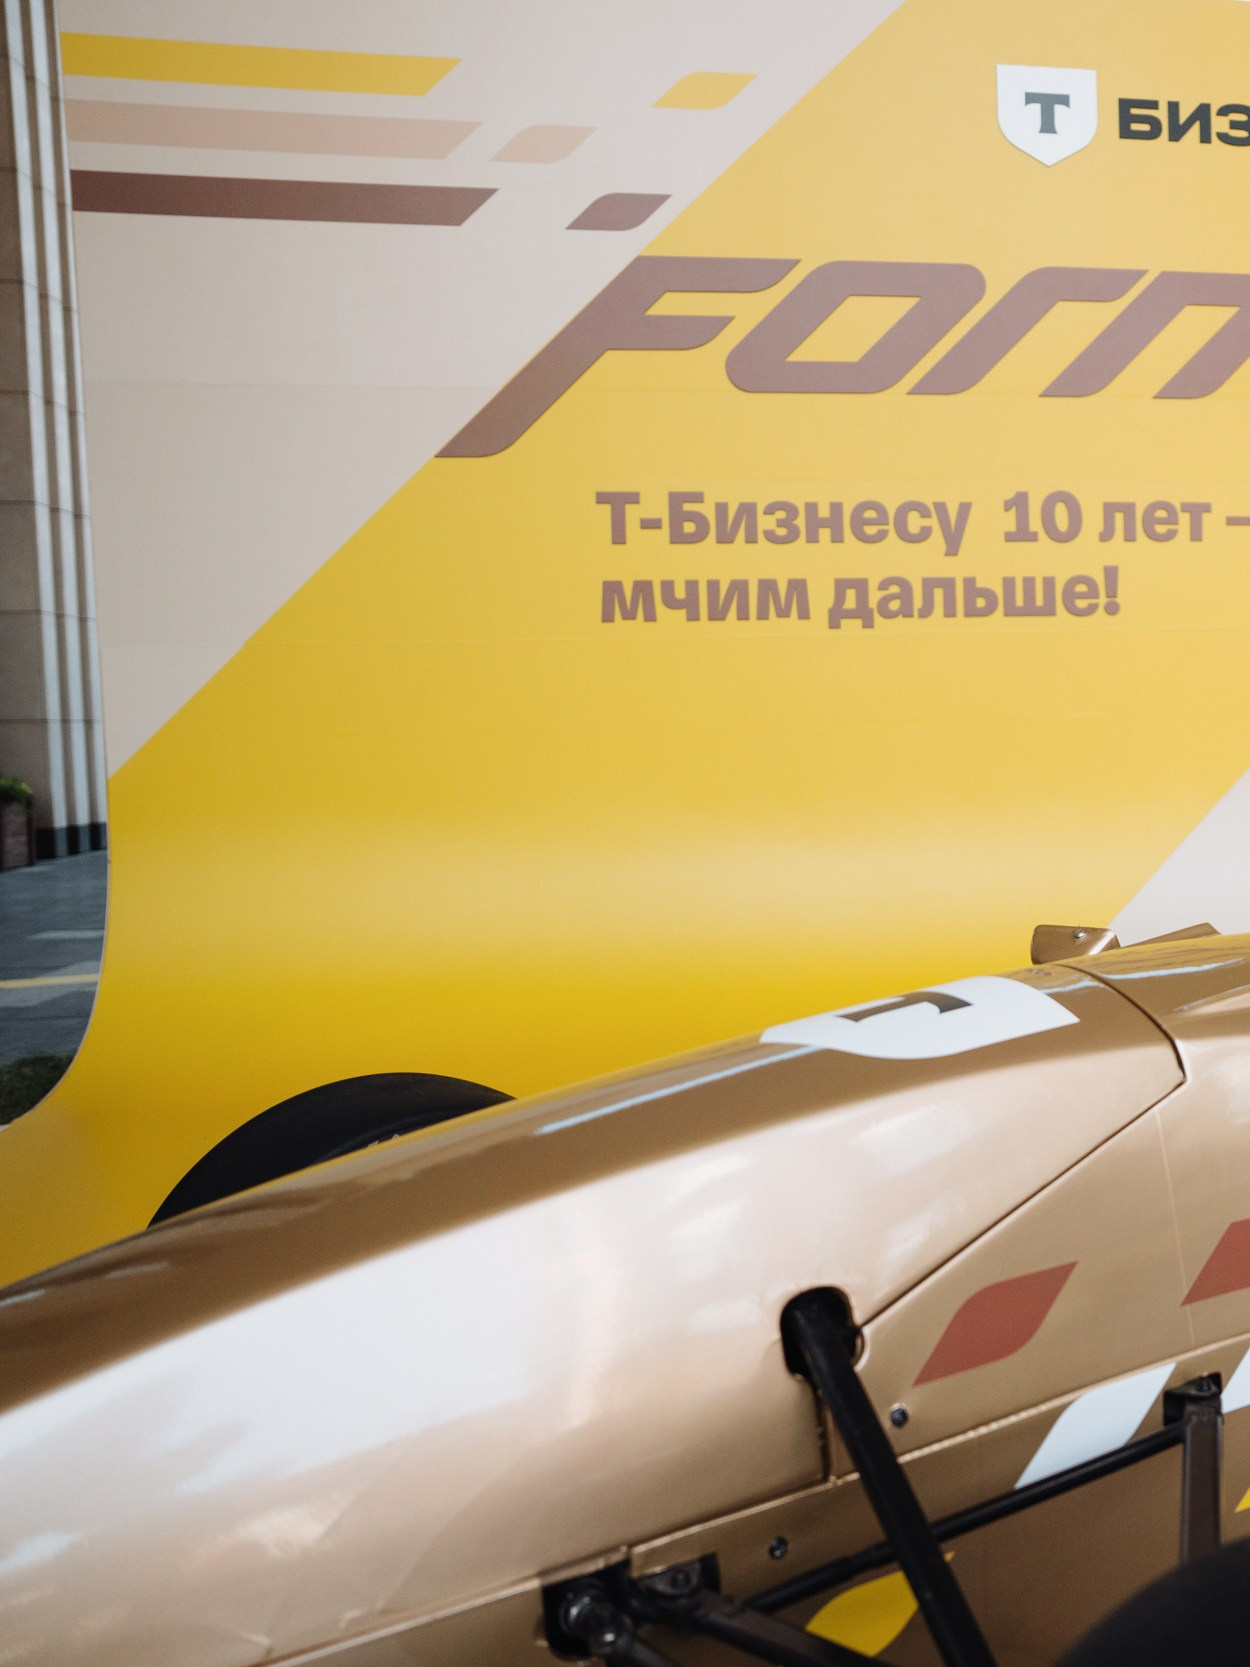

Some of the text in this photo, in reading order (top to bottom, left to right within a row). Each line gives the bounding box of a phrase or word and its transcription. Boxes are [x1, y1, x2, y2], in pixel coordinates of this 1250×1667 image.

[595, 490, 972, 557] Т-Бизнесу
[1003, 490, 1083, 543] 10
[1099, 500, 1212, 543] лет
[601, 565, 1121, 629] мчим дальше!
